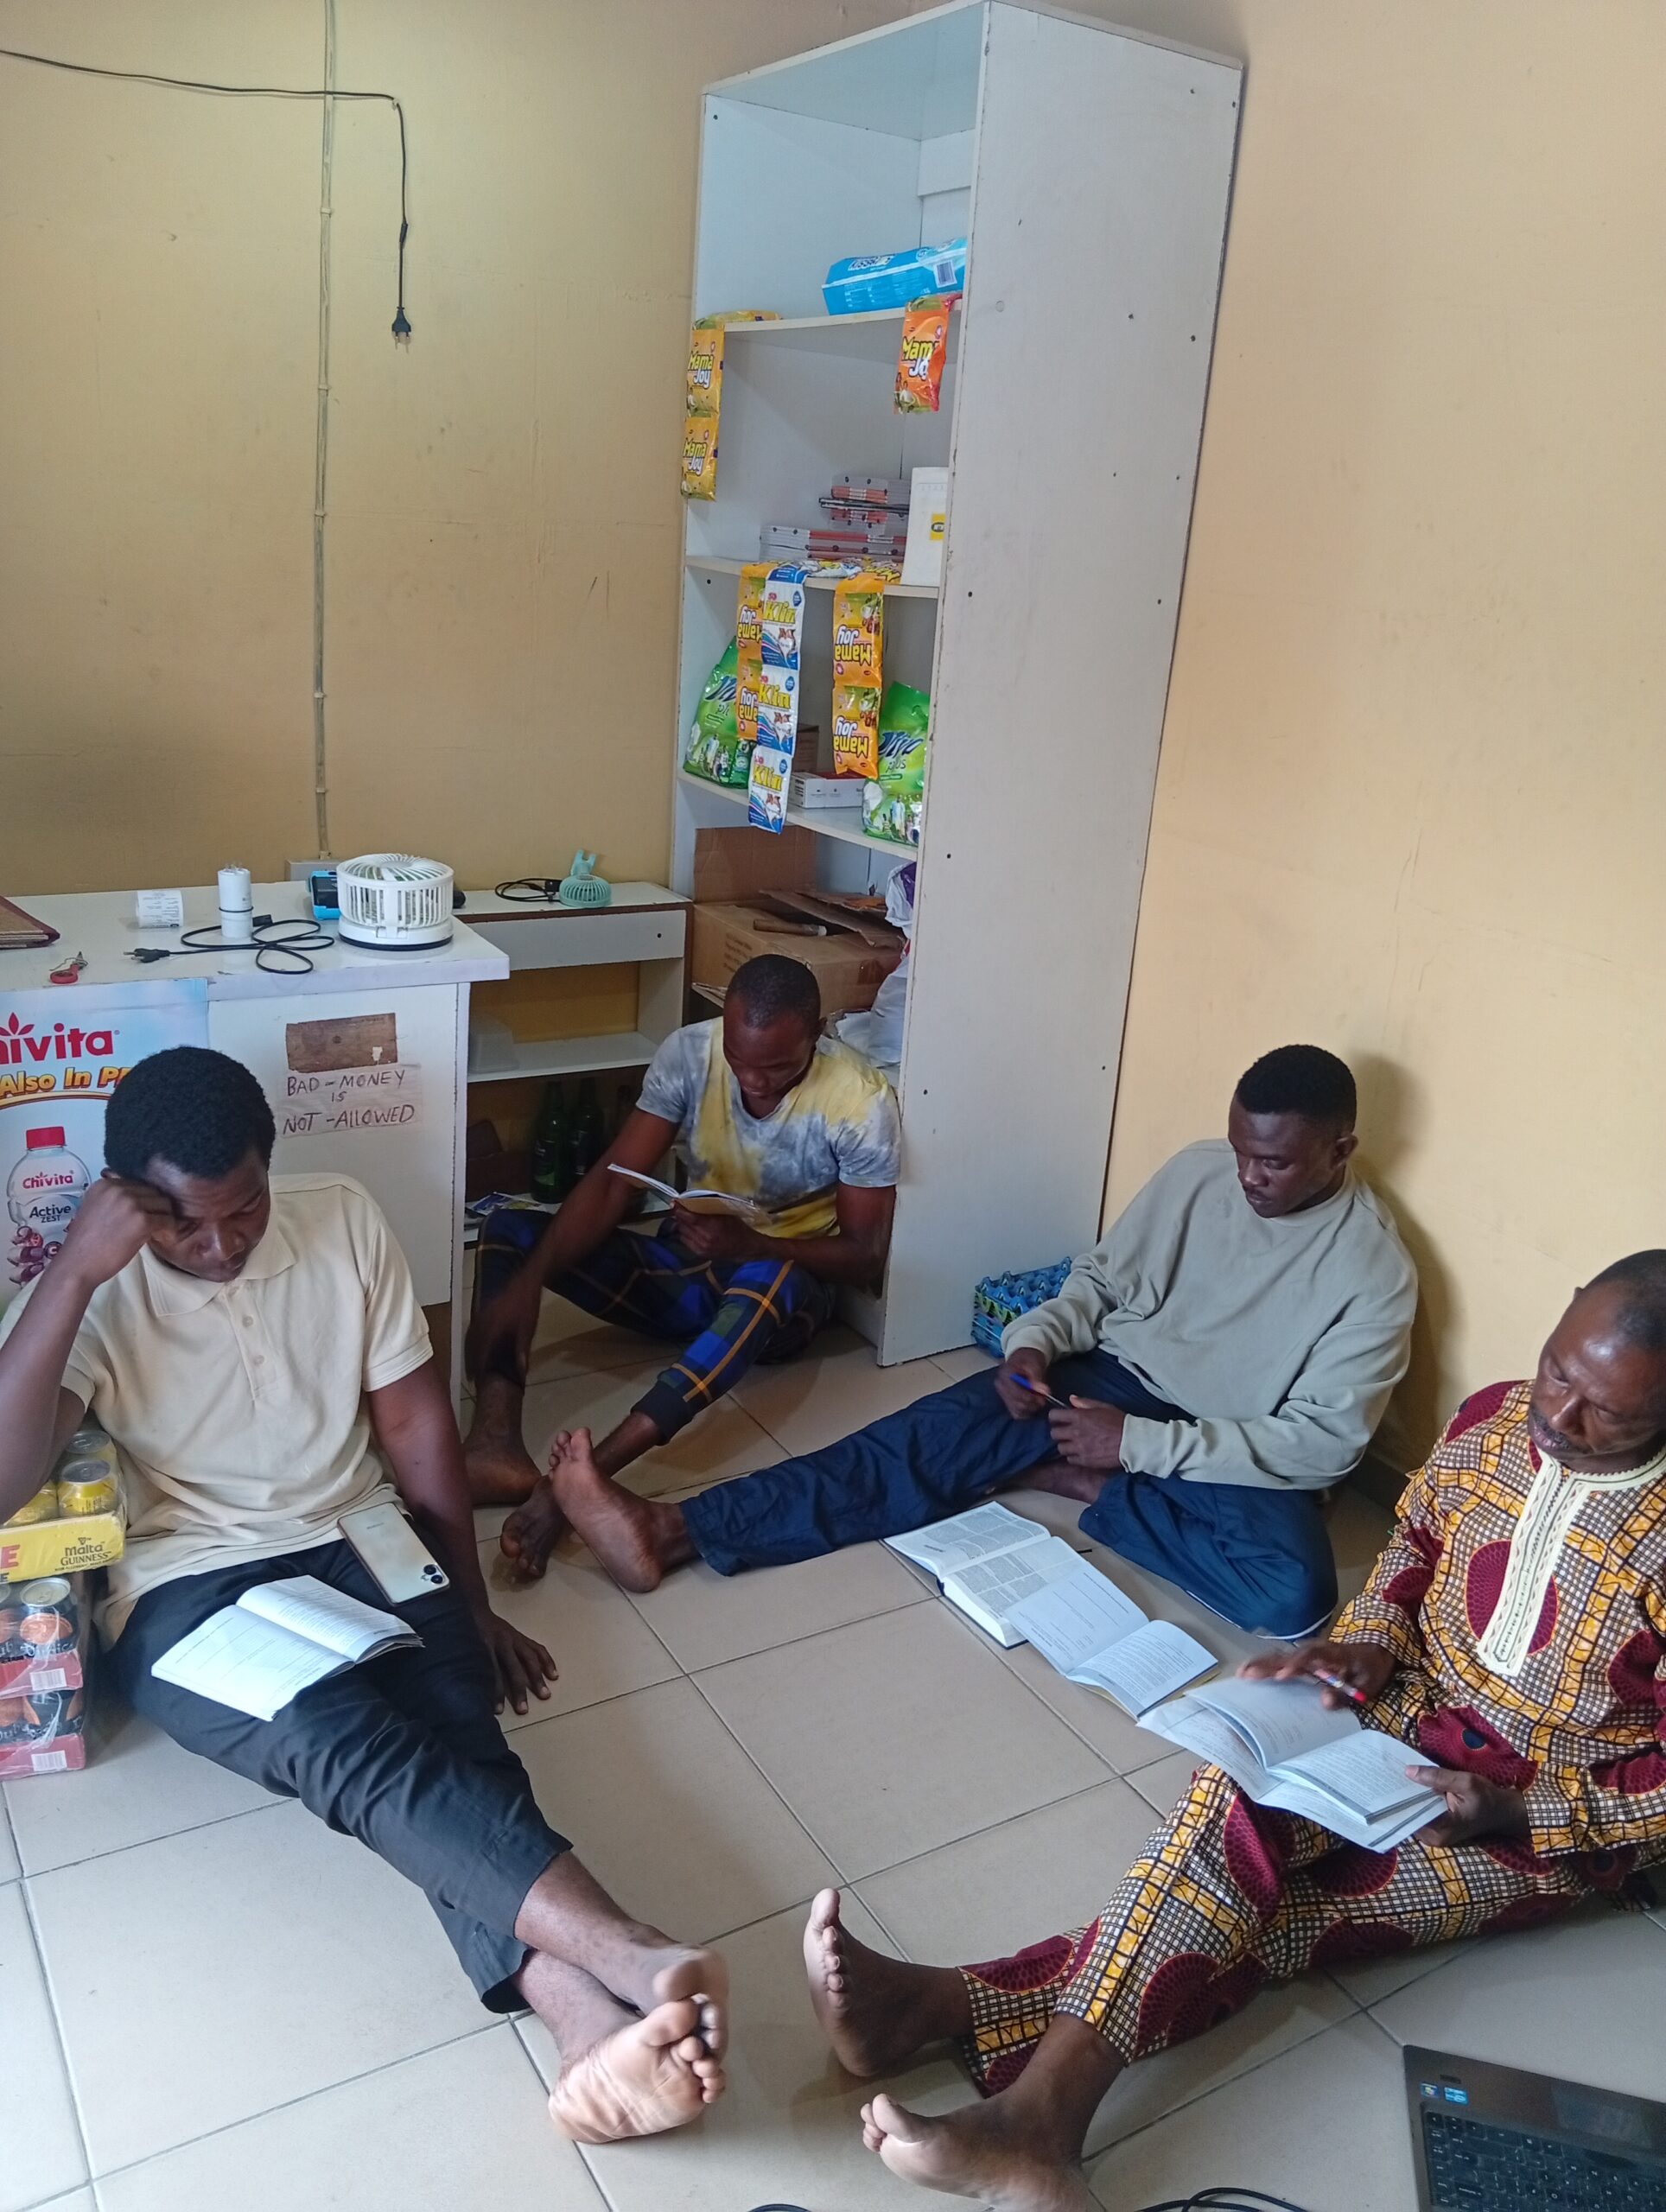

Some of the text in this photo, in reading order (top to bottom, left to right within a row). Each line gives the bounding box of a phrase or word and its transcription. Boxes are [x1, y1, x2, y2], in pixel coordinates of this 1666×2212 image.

[902, 336, 939, 361] Mam
[688, 351, 714, 372] Mama
[908, 359, 930, 380] Jo
[693, 370, 711, 389] Joy
[683, 438, 707, 458] Mama
[688, 456, 704, 475] Joy
[740, 604, 757, 625] Joy
[763, 601, 797, 625] Klin
[836, 624, 859, 648] Joy
[834, 642, 872, 666] Mama
[740, 686, 758, 708] Joy
[758, 683, 792, 709] Klin
[835, 715, 858, 740] Joy
[833, 734, 868, 759] Mama
[752, 763, 784, 792] Klin
[0, 1070, 56, 1099] Also
[64, 1067, 92, 1090] In
[287, 1076, 320, 1096] BAD
[340, 1070, 404, 1089] MONEY
[283, 1112, 322, 1135] NOT
[22, 1173, 73, 1189] Chivita
[29, 1205, 72, 1218] Active
[41, 1215, 60, 1224] ZEST
[60, 1553, 109, 1567] GUINNESS
